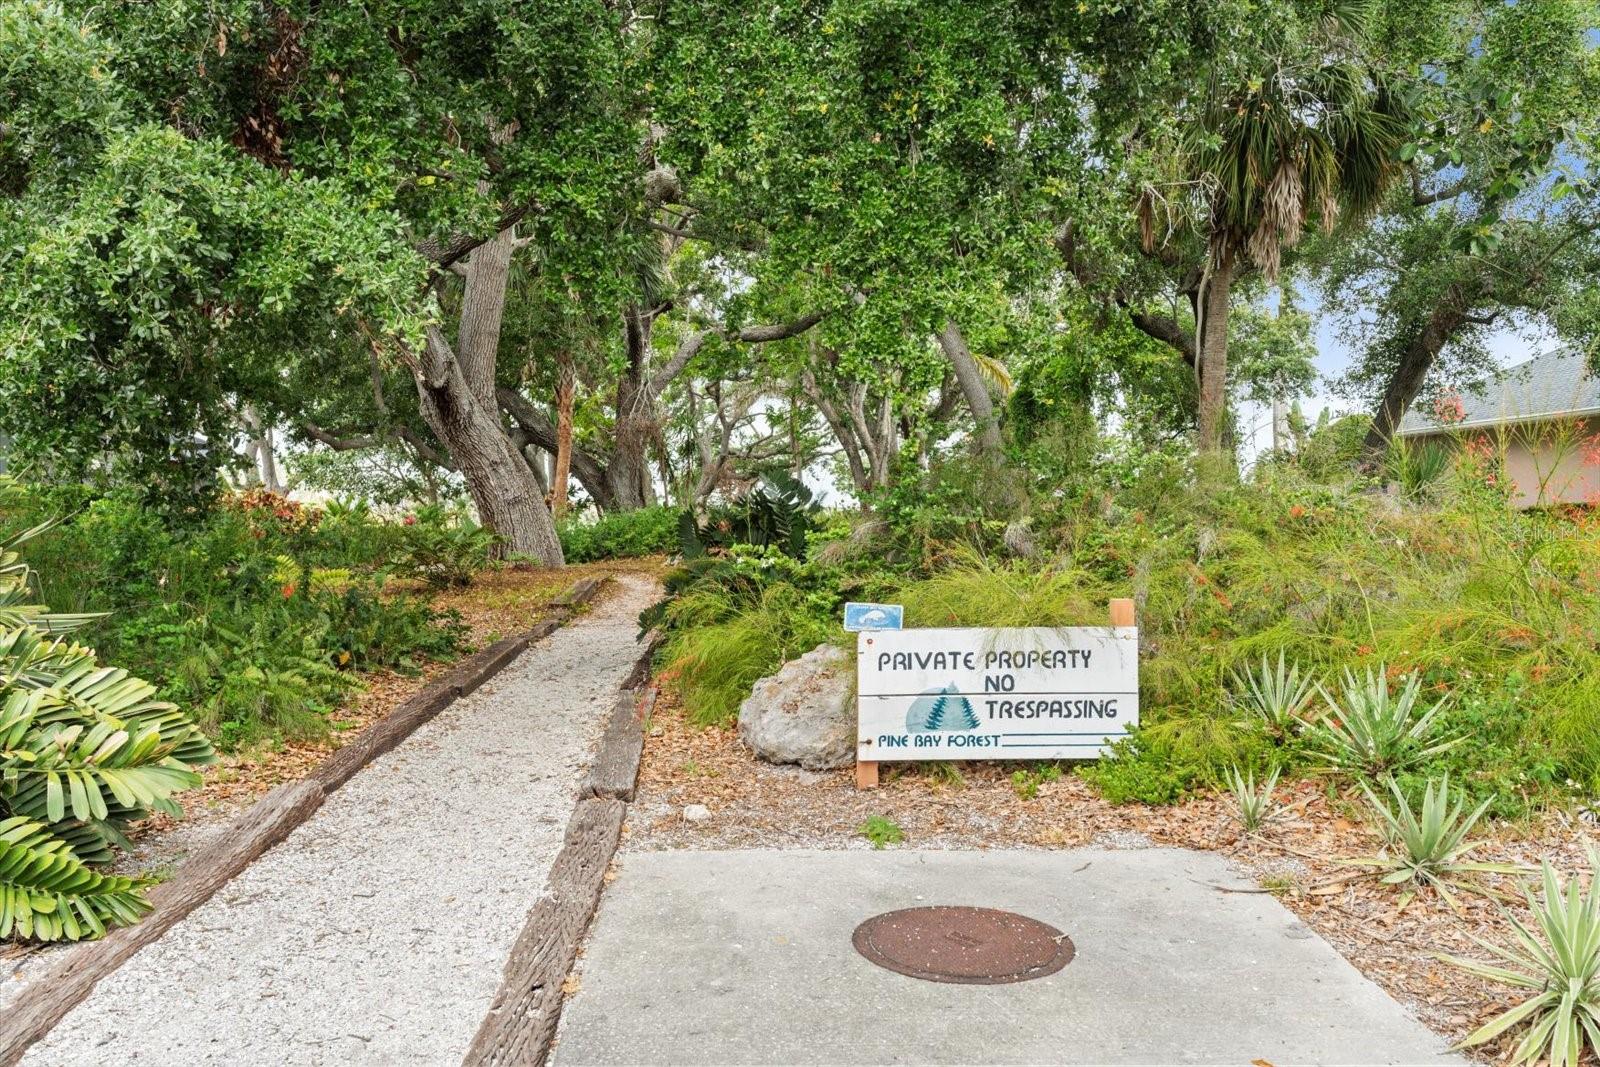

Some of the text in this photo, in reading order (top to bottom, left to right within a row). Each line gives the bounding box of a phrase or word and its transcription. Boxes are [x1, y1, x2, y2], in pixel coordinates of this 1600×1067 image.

[878, 649, 1092, 672] PRIVATE PROPERTY
[984, 673, 1016, 692] NO
[985, 699, 1118, 720] TRESPASSING
[878, 734, 1001, 748] PINE BAY FOREST
